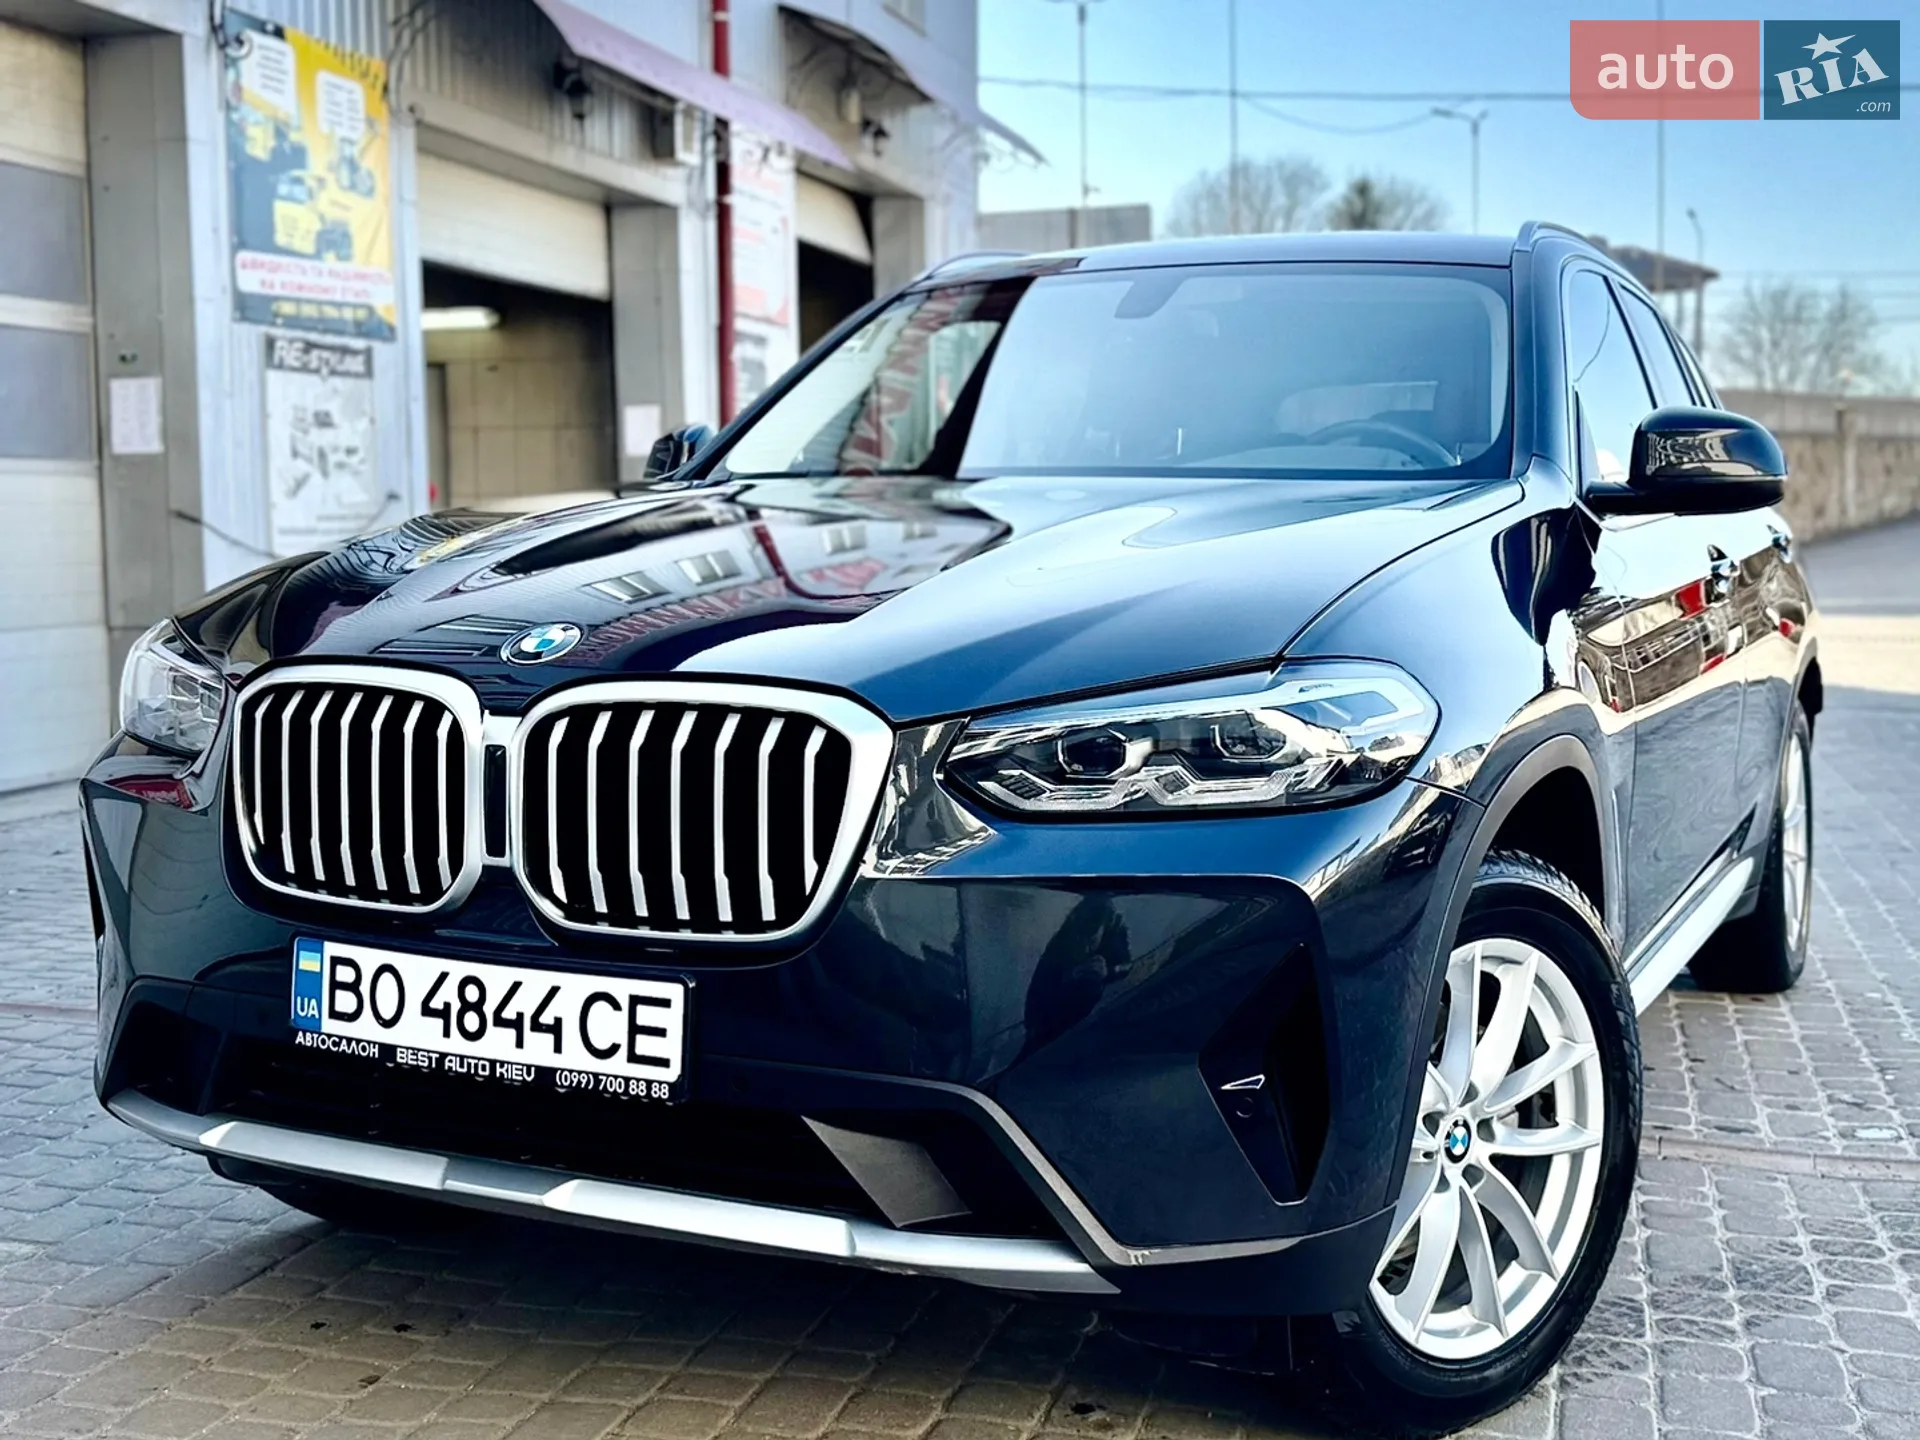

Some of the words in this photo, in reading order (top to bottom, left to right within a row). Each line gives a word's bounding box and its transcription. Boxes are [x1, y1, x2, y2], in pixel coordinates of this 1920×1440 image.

[296, 996, 320, 1019] UA
[327, 955, 406, 1029] BO
[421, 971, 563, 1054] 4844
[578, 991, 672, 1069] CE
[295, 1030, 379, 1059] АВТОСАЛОН
[396, 1046, 440, 1069] BEST
[444, 1055, 491, 1076] AUTO
[496, 1061, 536, 1082] KIEV
[555, 1069, 594, 1090] (099)
[598, 1075, 625, 1094] 700
[628, 1079, 647, 1097] 88
[650, 1081, 670, 1100] 88
